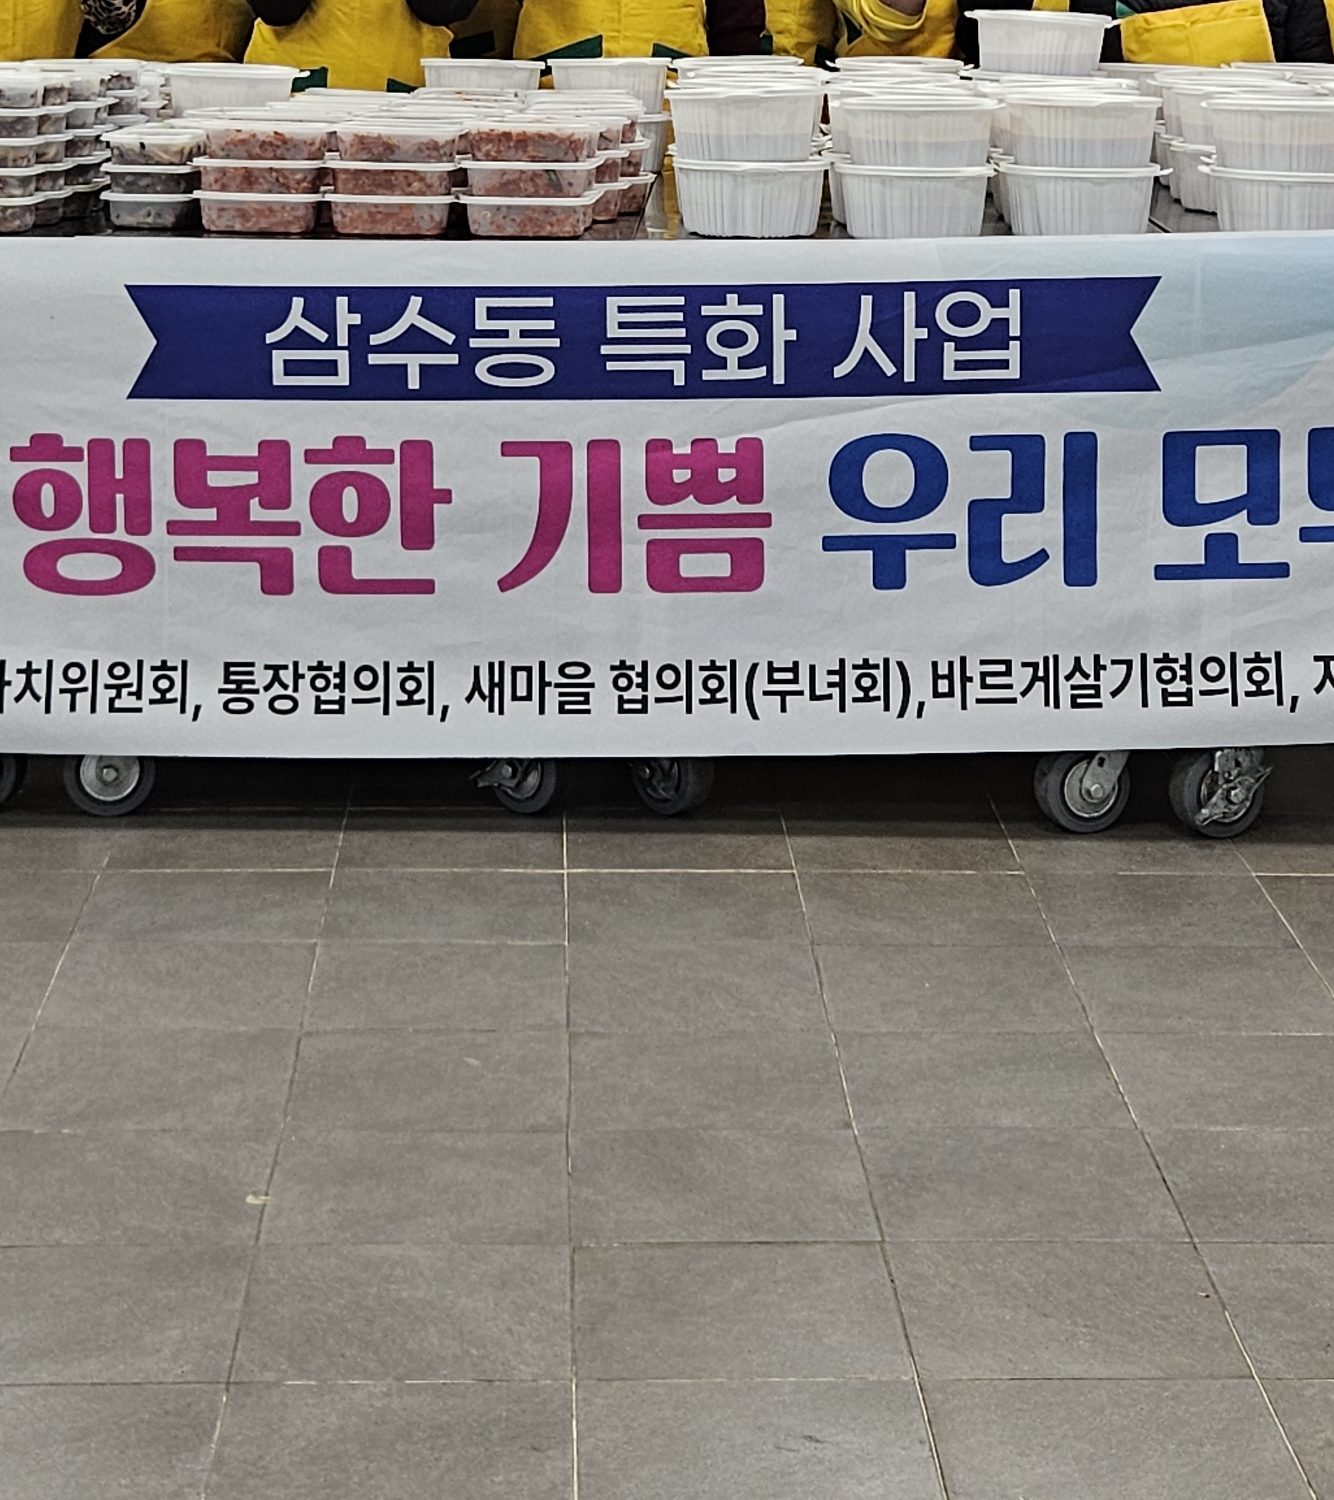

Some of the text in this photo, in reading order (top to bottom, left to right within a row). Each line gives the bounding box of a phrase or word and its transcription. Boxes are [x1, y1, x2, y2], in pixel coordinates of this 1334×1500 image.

[263, 288, 1023, 391] 삼수동 특화 사업
[8, 432, 453, 596] 행복한
[496, 435, 773, 594] 기쁨
[821, 430, 1099, 591] 우리
[216, 658, 451, 722] 통장협의회,
[463, 658, 596, 716] 새마을
